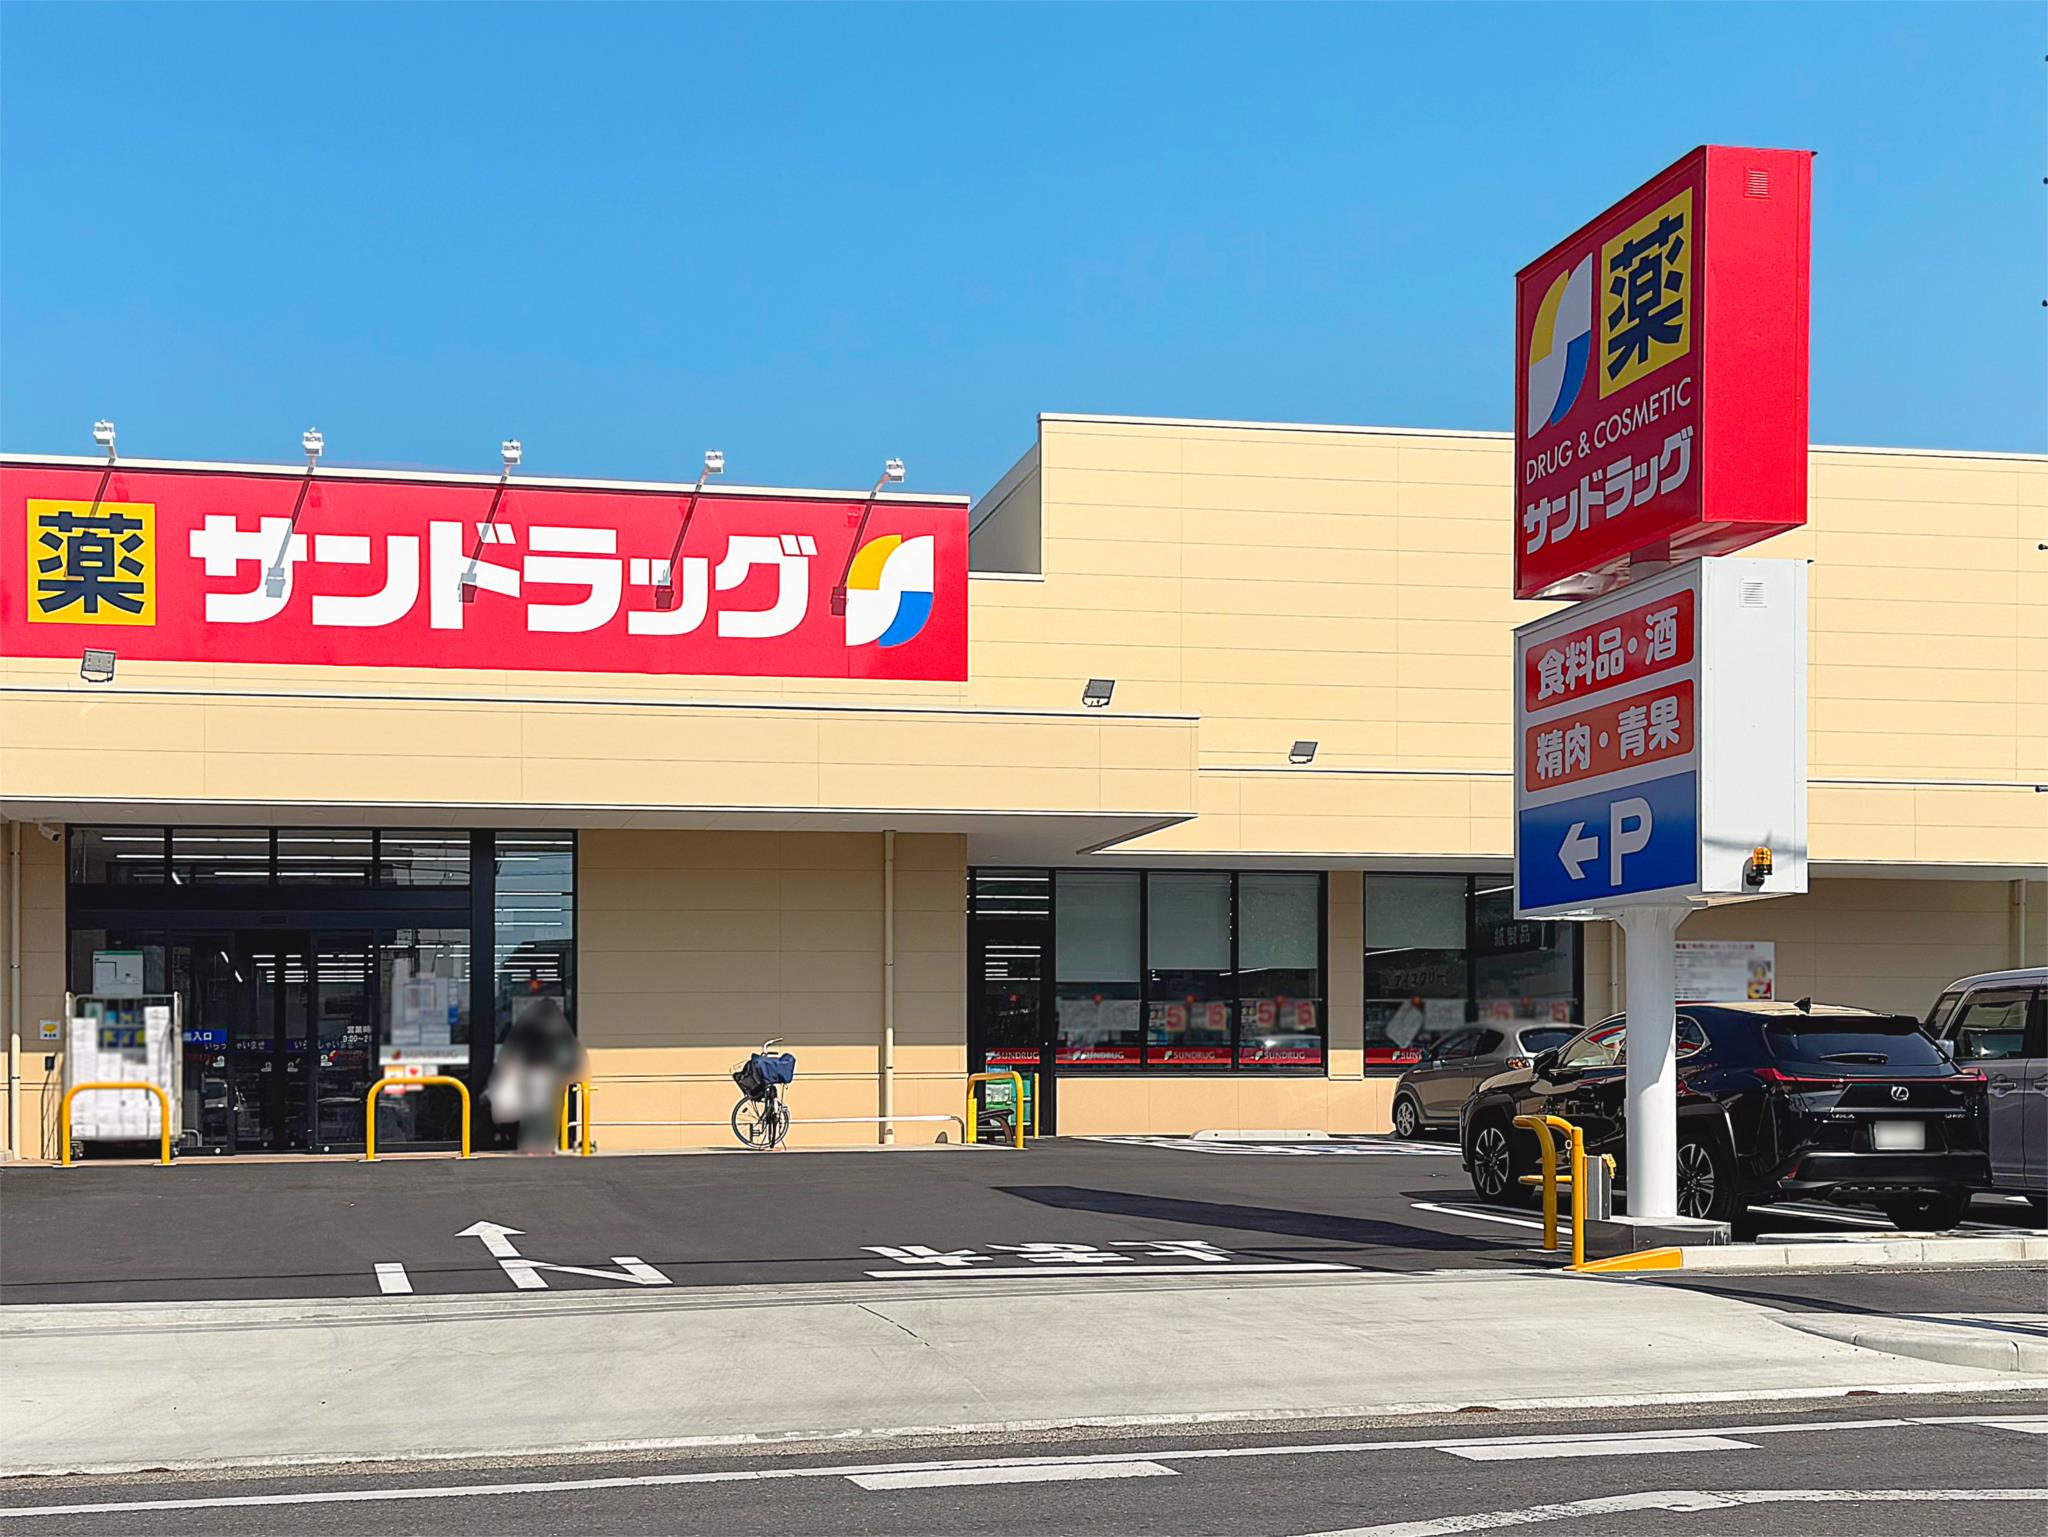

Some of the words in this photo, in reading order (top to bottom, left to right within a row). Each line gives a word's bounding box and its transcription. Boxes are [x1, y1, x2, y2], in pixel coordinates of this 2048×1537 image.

[1607, 211, 1684, 381] 薬
[1526, 438, 1574, 486] DRUG
[1577, 433, 1592, 459] &
[1594, 376, 1692, 450] COSMETIC
[1523, 425, 1694, 555] サンドラッグ
[38, 511, 144, 614] 薬
[189, 514, 818, 638] サンドラッグ
[1537, 606, 1678, 700] 食料品・酒
[1536, 696, 1680, 780] 精肉・青果
[1610, 797, 1653, 886] P
[996, 1050, 1040, 1060] SUNDRUG
[1173, 1050, 1216, 1060] SUNDRUG
[1264, 1050, 1306, 1060] SUNDRUG
